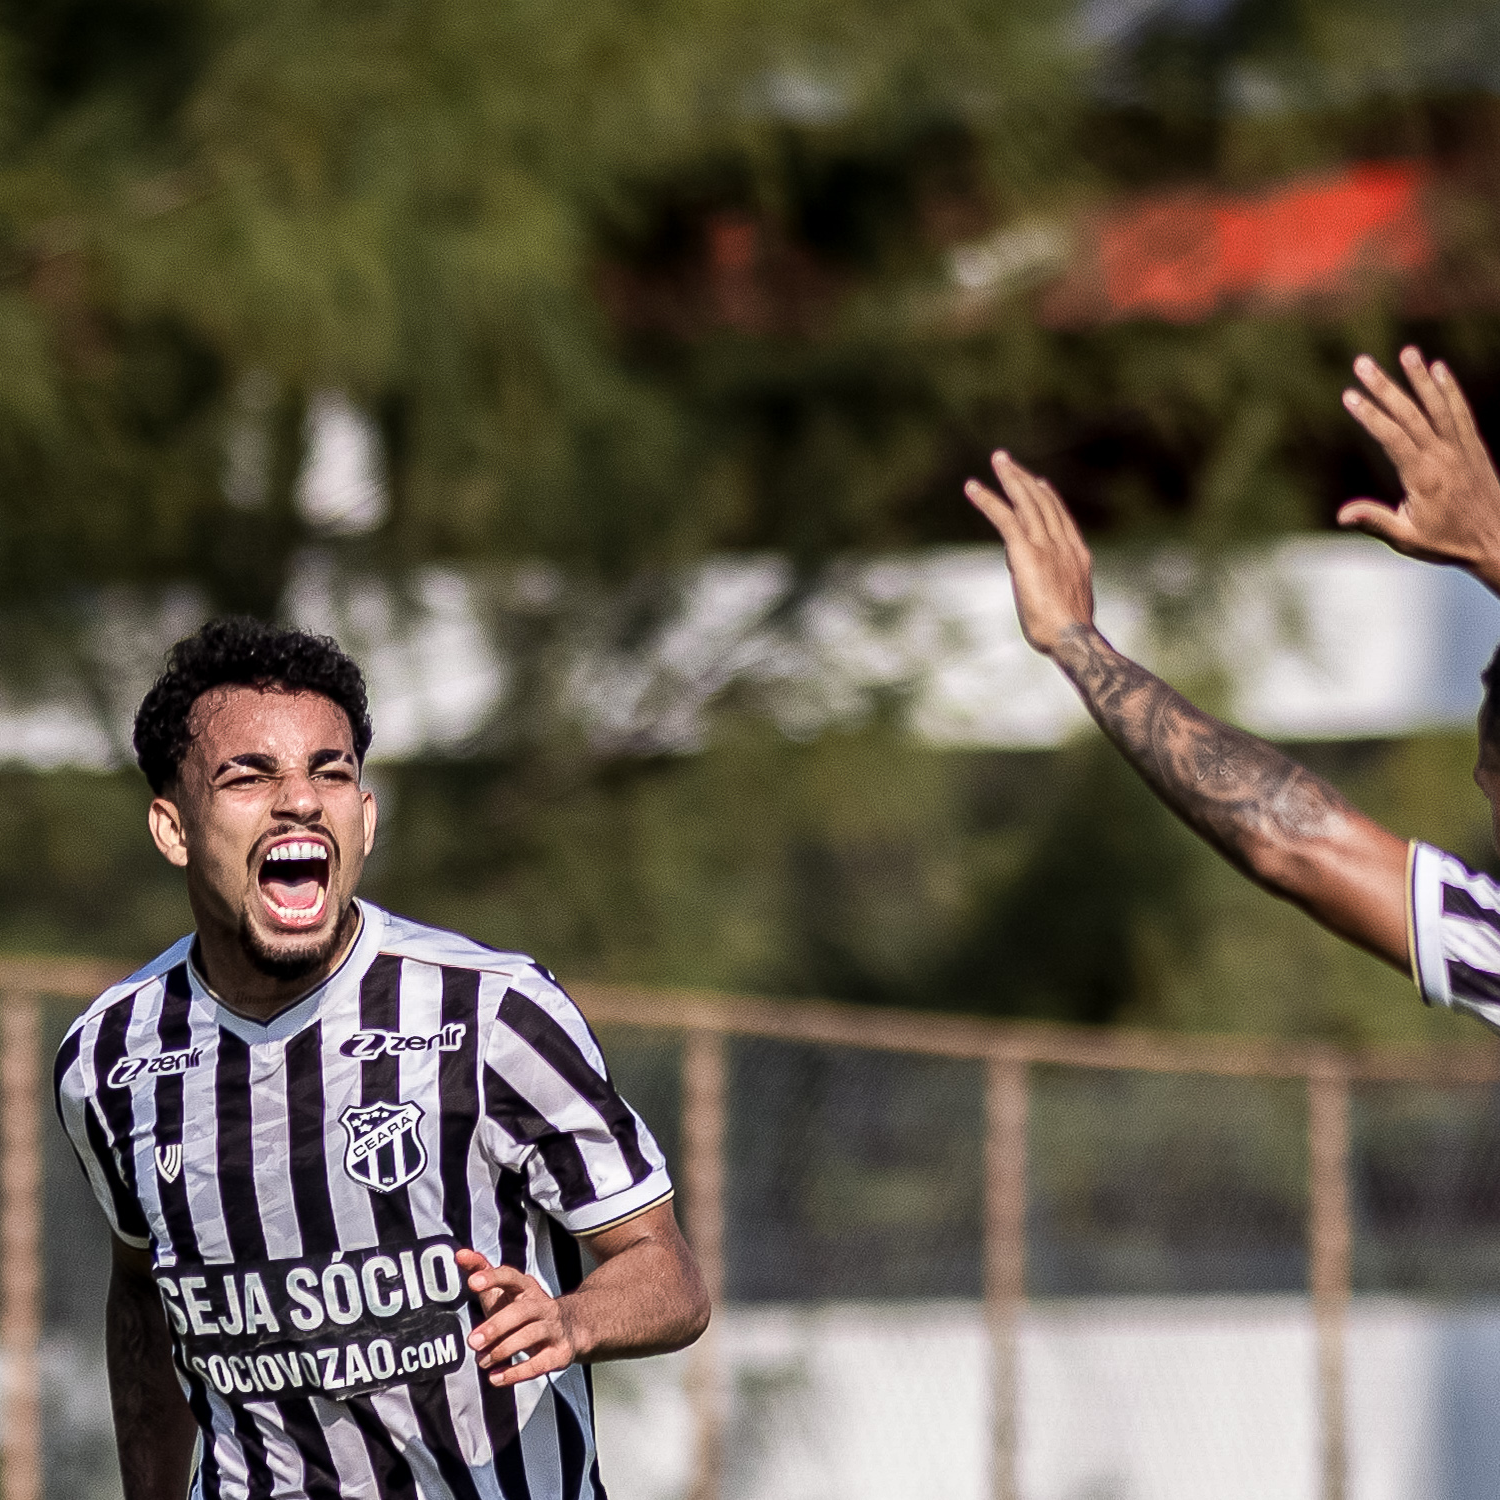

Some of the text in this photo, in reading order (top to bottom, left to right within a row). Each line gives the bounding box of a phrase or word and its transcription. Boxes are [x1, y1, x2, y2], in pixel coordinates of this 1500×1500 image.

[389, 1024, 464, 1052] zenir
[147, 1048, 203, 1074] zenir
[156, 1243, 461, 1336] SEJA SÓCIO
